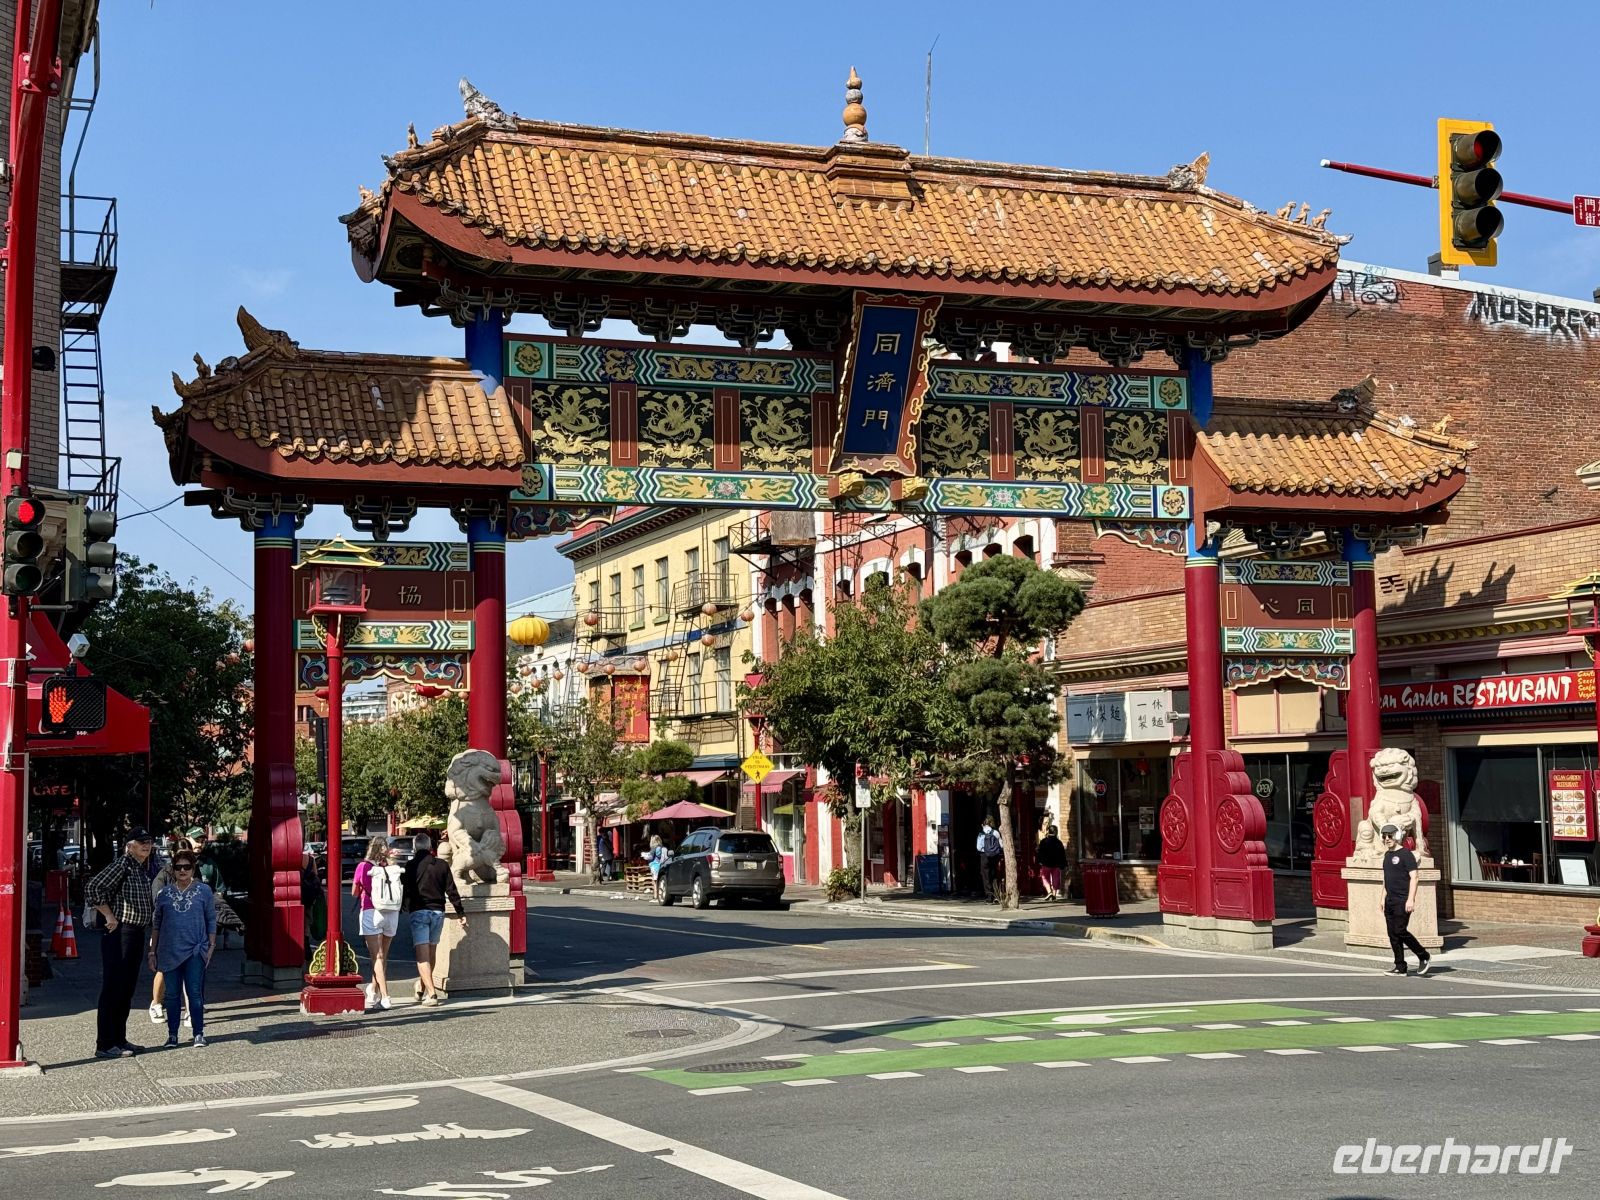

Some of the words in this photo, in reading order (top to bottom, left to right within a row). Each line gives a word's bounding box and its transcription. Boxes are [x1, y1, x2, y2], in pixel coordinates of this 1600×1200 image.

[1401, 685, 1448, 709] Garden
[1453, 676, 1572, 706] RESTAURANT
[33, 785, 71, 796] CAFE
